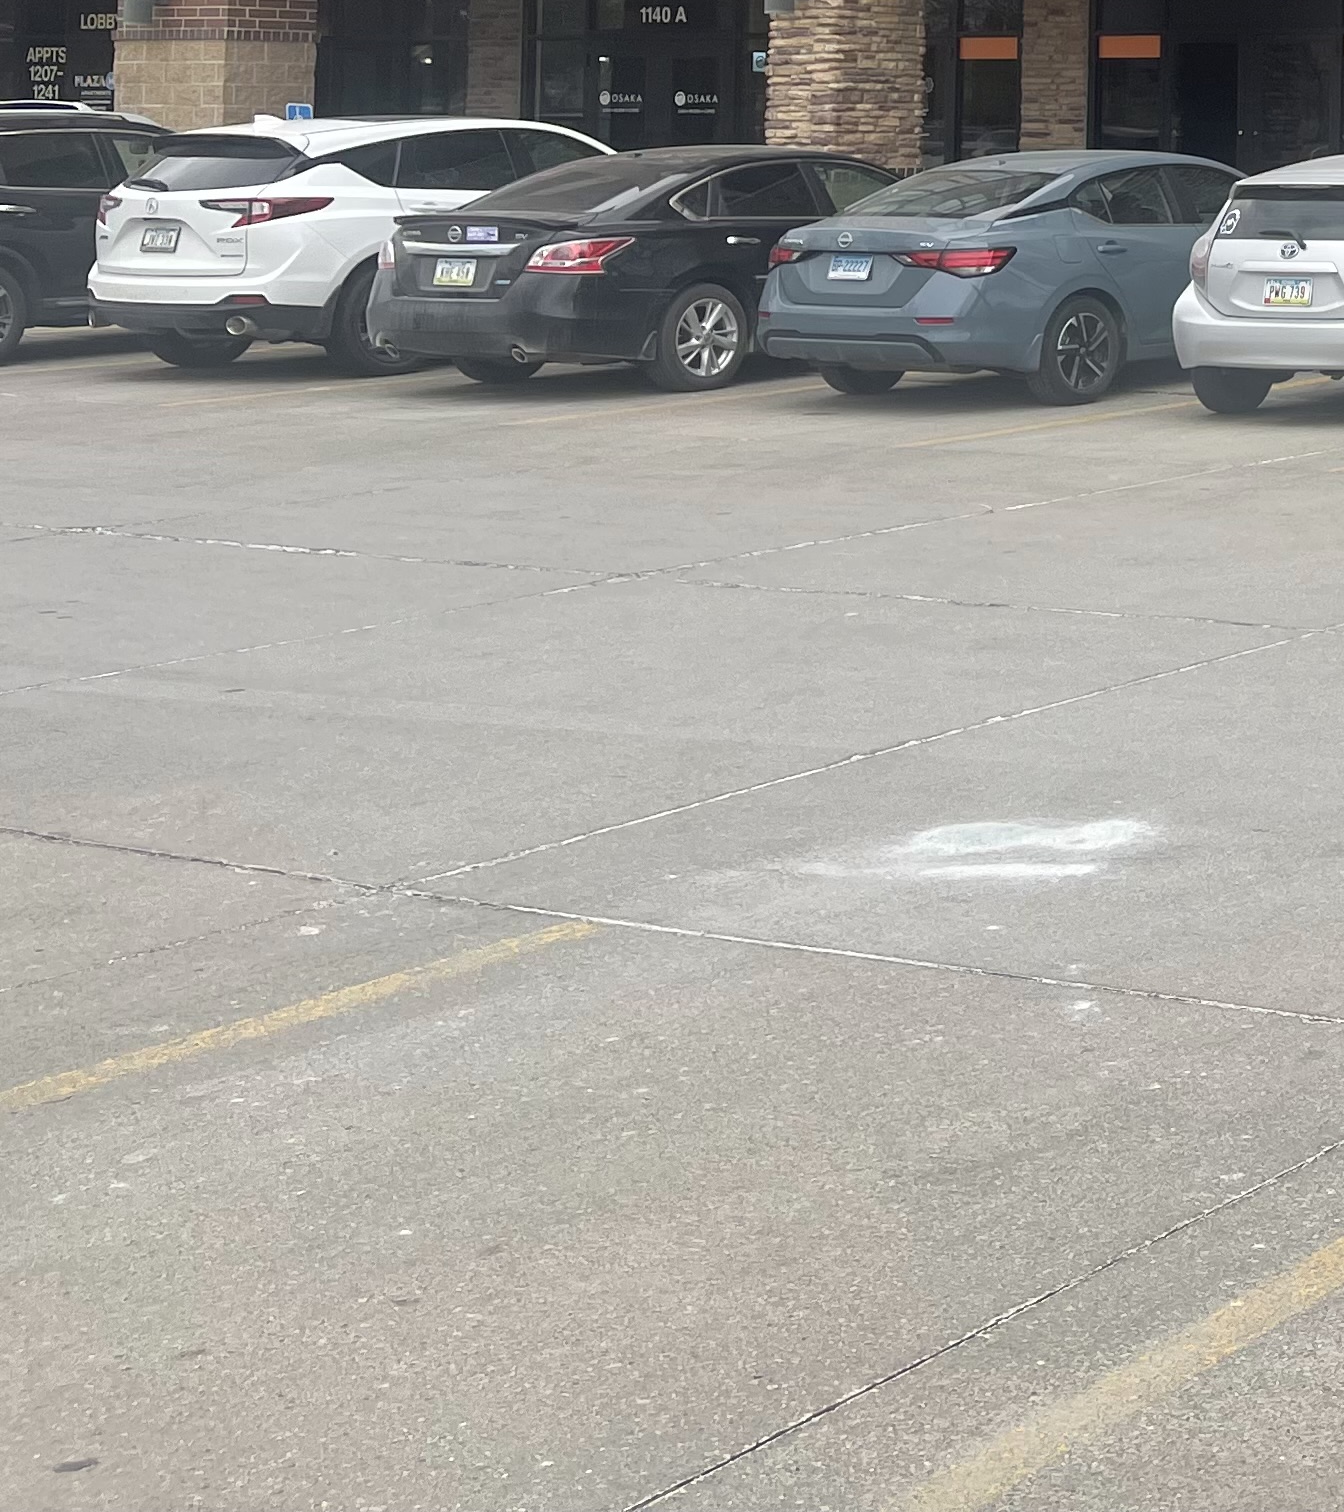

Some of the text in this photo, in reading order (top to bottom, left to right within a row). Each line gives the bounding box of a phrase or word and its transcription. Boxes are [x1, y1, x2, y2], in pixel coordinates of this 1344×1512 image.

[639, 6, 688, 23] 1140 A
[26, 47, 67, 63] APPTS
[33, 84, 59, 100] 1241
[611, 93, 643, 103] OSAKA
[687, 94, 718, 104] OSAKA
[1289, 285, 1306, 299] 739
